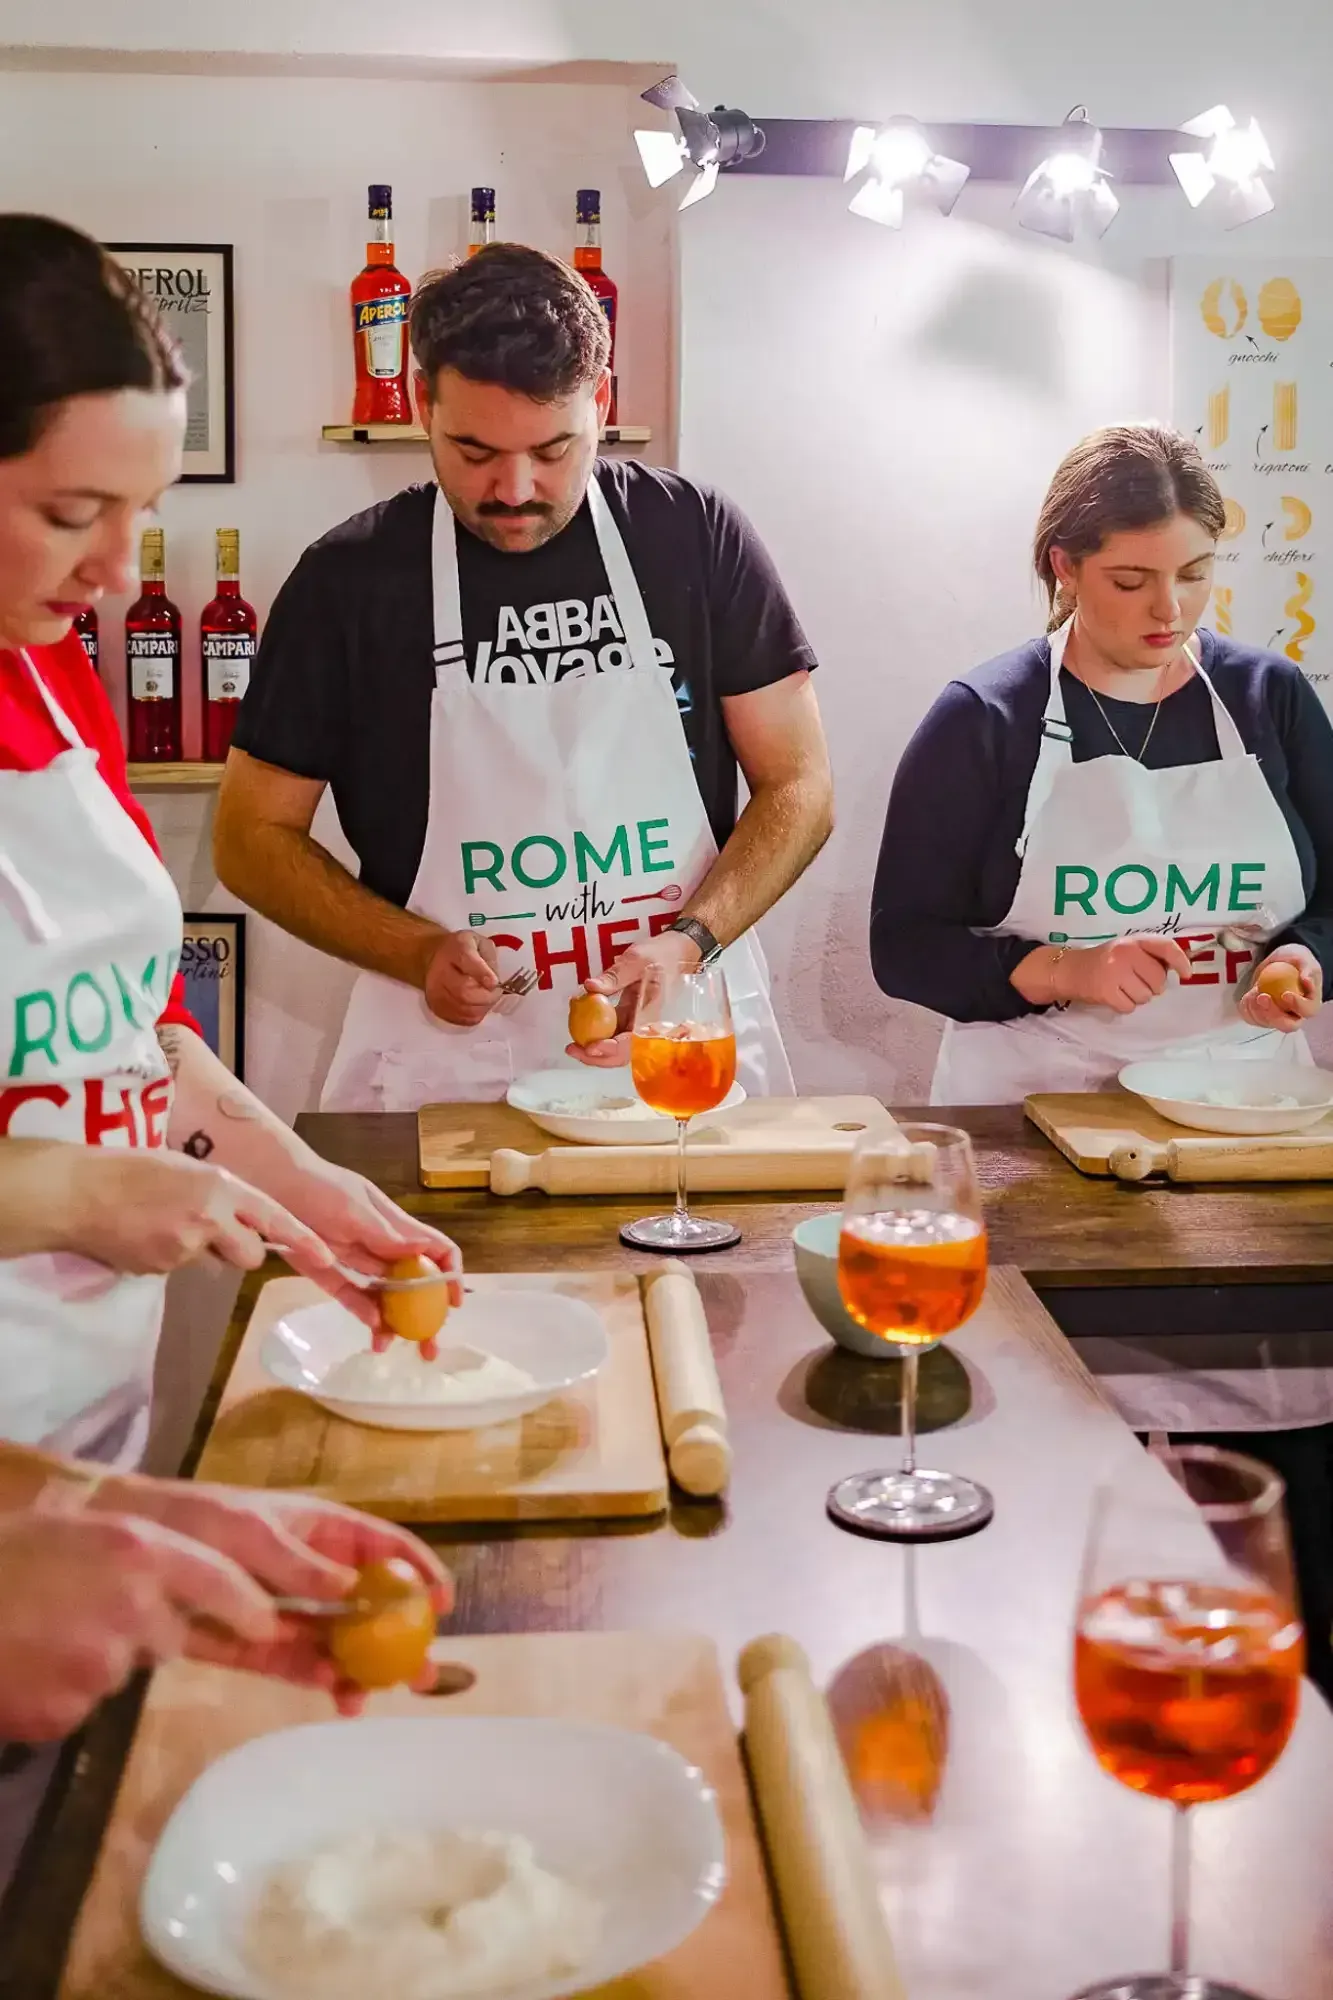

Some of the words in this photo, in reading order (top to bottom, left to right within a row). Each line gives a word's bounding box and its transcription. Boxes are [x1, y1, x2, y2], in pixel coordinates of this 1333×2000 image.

[359, 302, 407, 326] APEROL
[1227, 351, 1280, 366] gnocchi
[1252, 461, 1311, 476] rigatoni
[1263, 550, 1316, 566] chifferi
[127, 640, 178, 655] CAMPARI
[203, 641, 256, 656] CAMPARI
[460, 818, 675, 894] ROME
[1054, 863, 1266, 916] ROME
[545, 880, 615, 924] with
